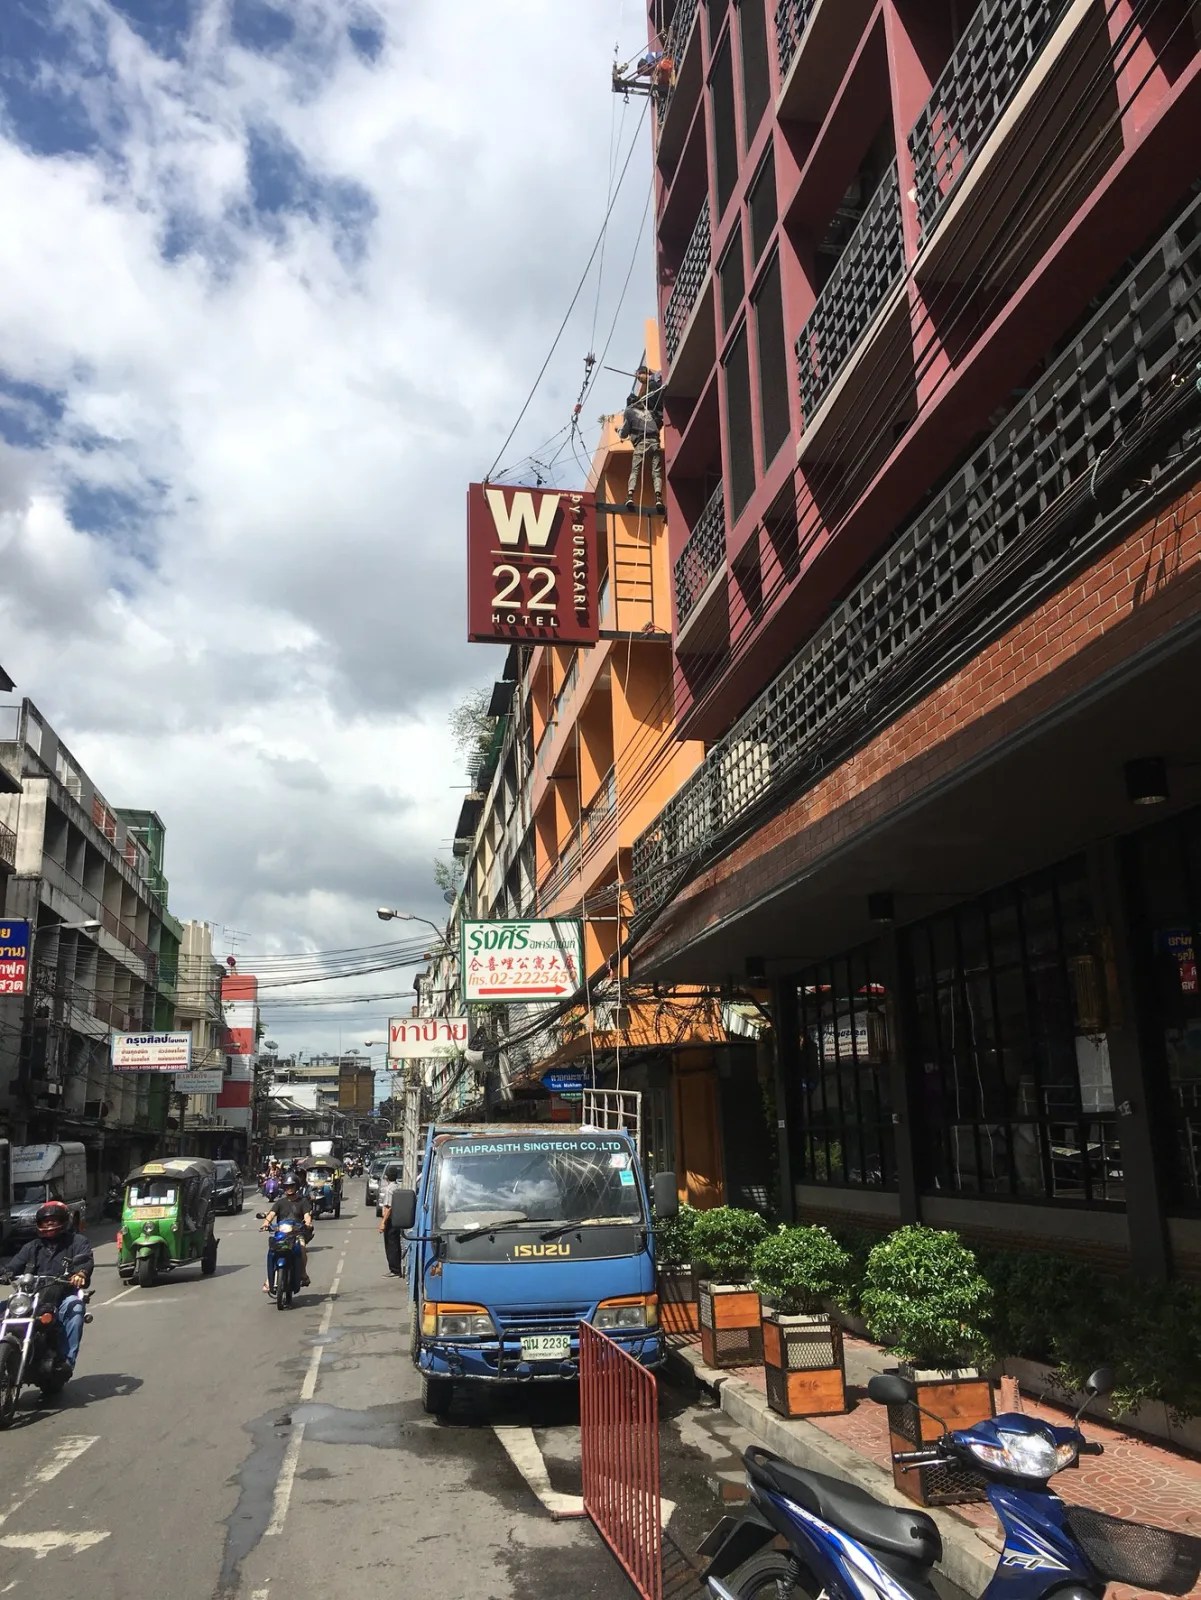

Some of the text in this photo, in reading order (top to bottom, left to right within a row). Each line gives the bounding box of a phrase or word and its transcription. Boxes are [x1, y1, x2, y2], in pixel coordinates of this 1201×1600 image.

[485, 489, 561, 548] W
[569, 494, 587, 611] by BURASARI
[491, 564, 557, 610] 22
[491, 614, 558, 626] HOTEL
[468, 925, 531, 956] รุ่งศิริ
[390, 1018, 467, 1042] ทำป้าย
[449, 1141, 621, 1155] THAIPRASITH SINGTECH CO.,LTD
[514, 1243, 571, 1257] ISUZU
[542, 1337, 569, 1349] 2238
[1003, 1554, 1045, 1571] FI
